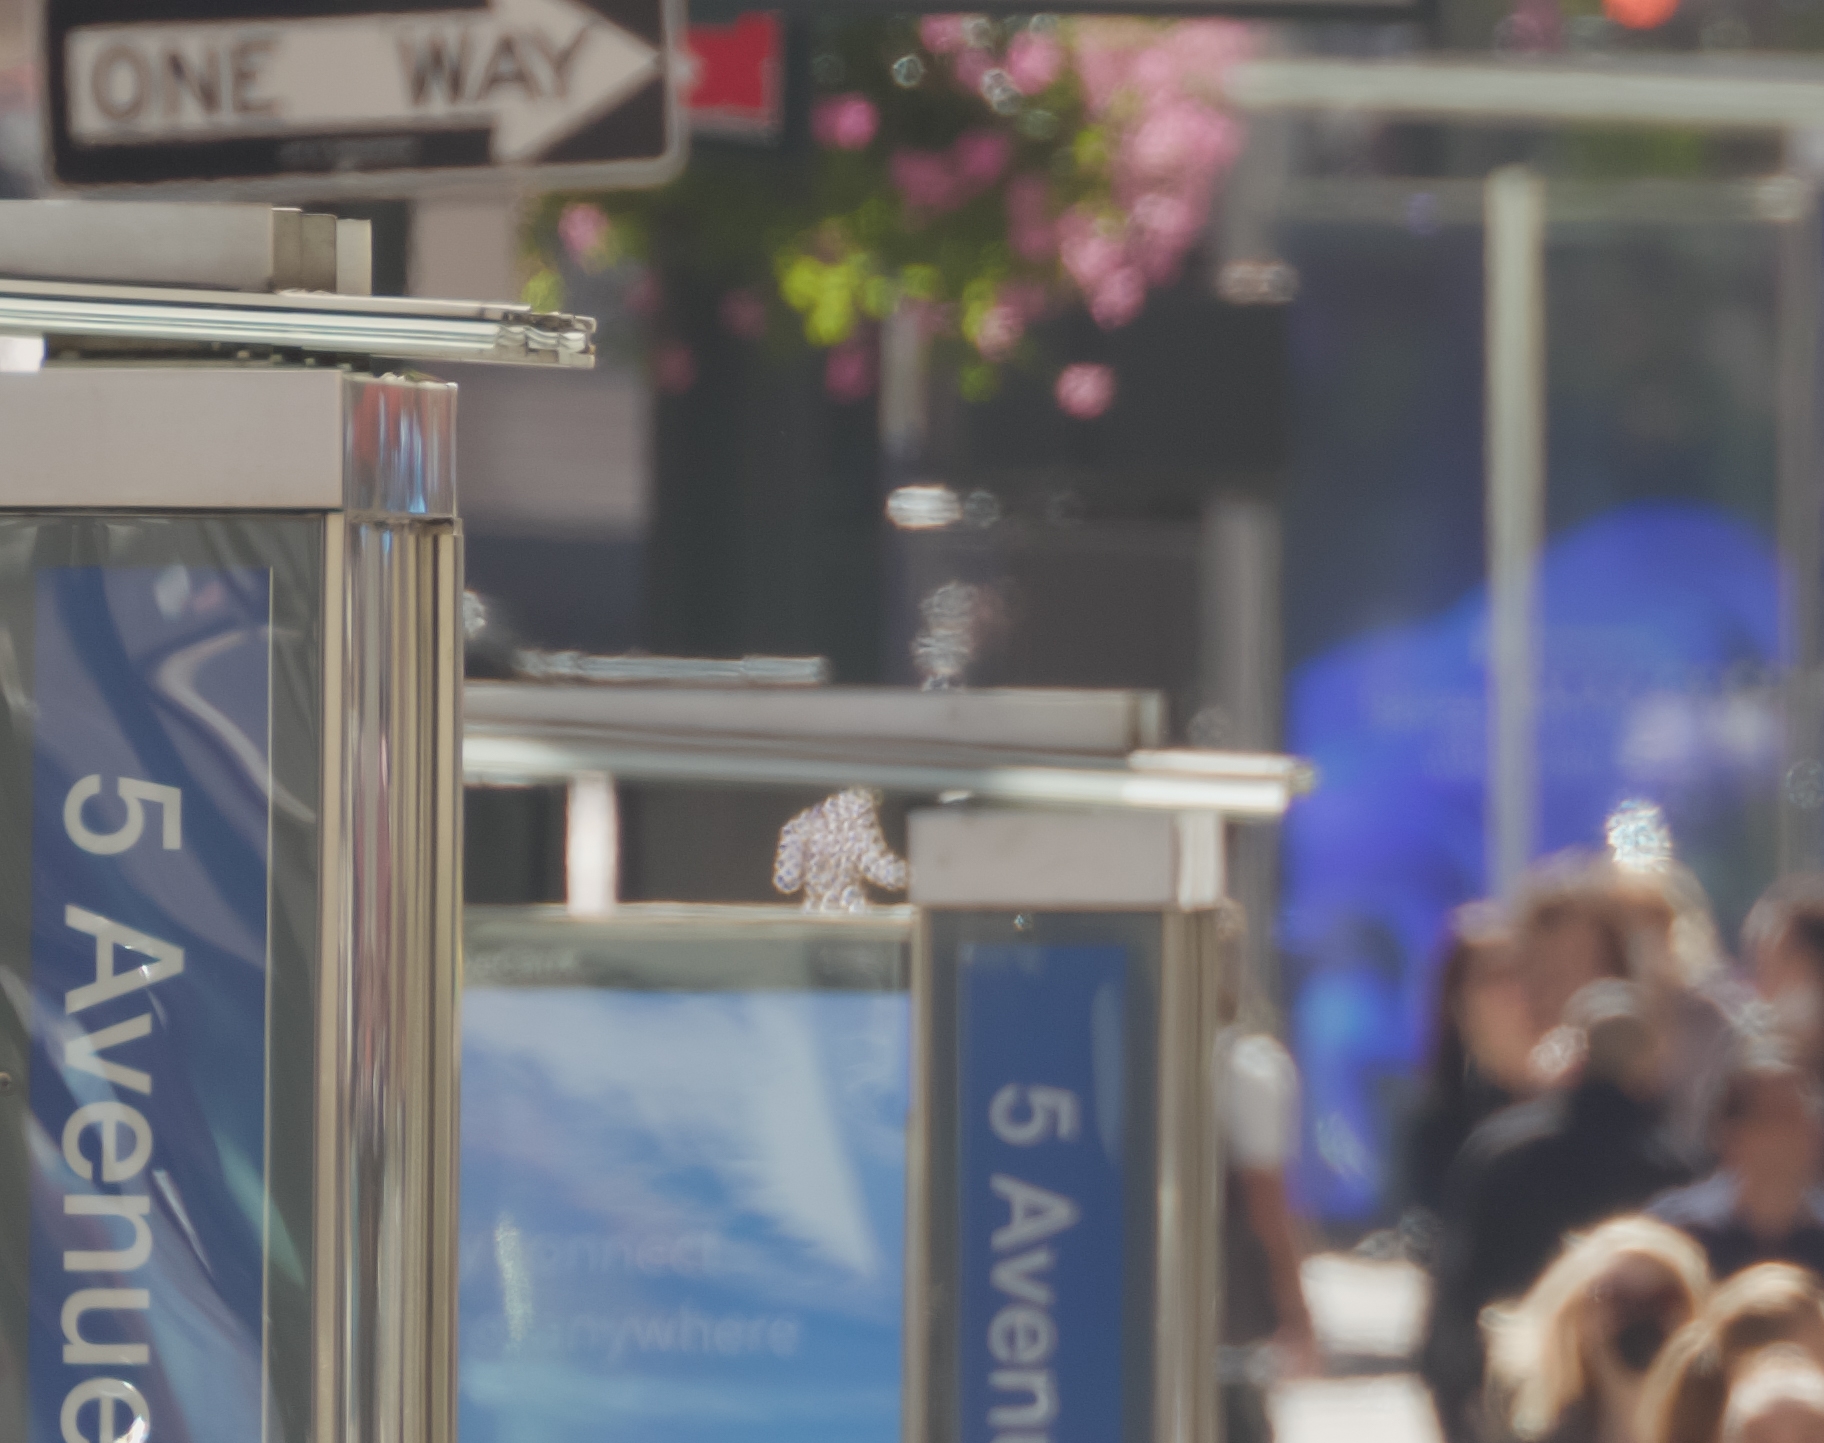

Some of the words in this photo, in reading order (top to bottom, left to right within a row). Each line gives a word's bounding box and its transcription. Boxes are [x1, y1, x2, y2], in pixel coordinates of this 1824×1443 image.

[90, 38, 279, 121] ONE
[402, 28, 586, 107] WAY
[63, 774, 182, 856] 5
[989, 1082, 1082, 1147] 5
